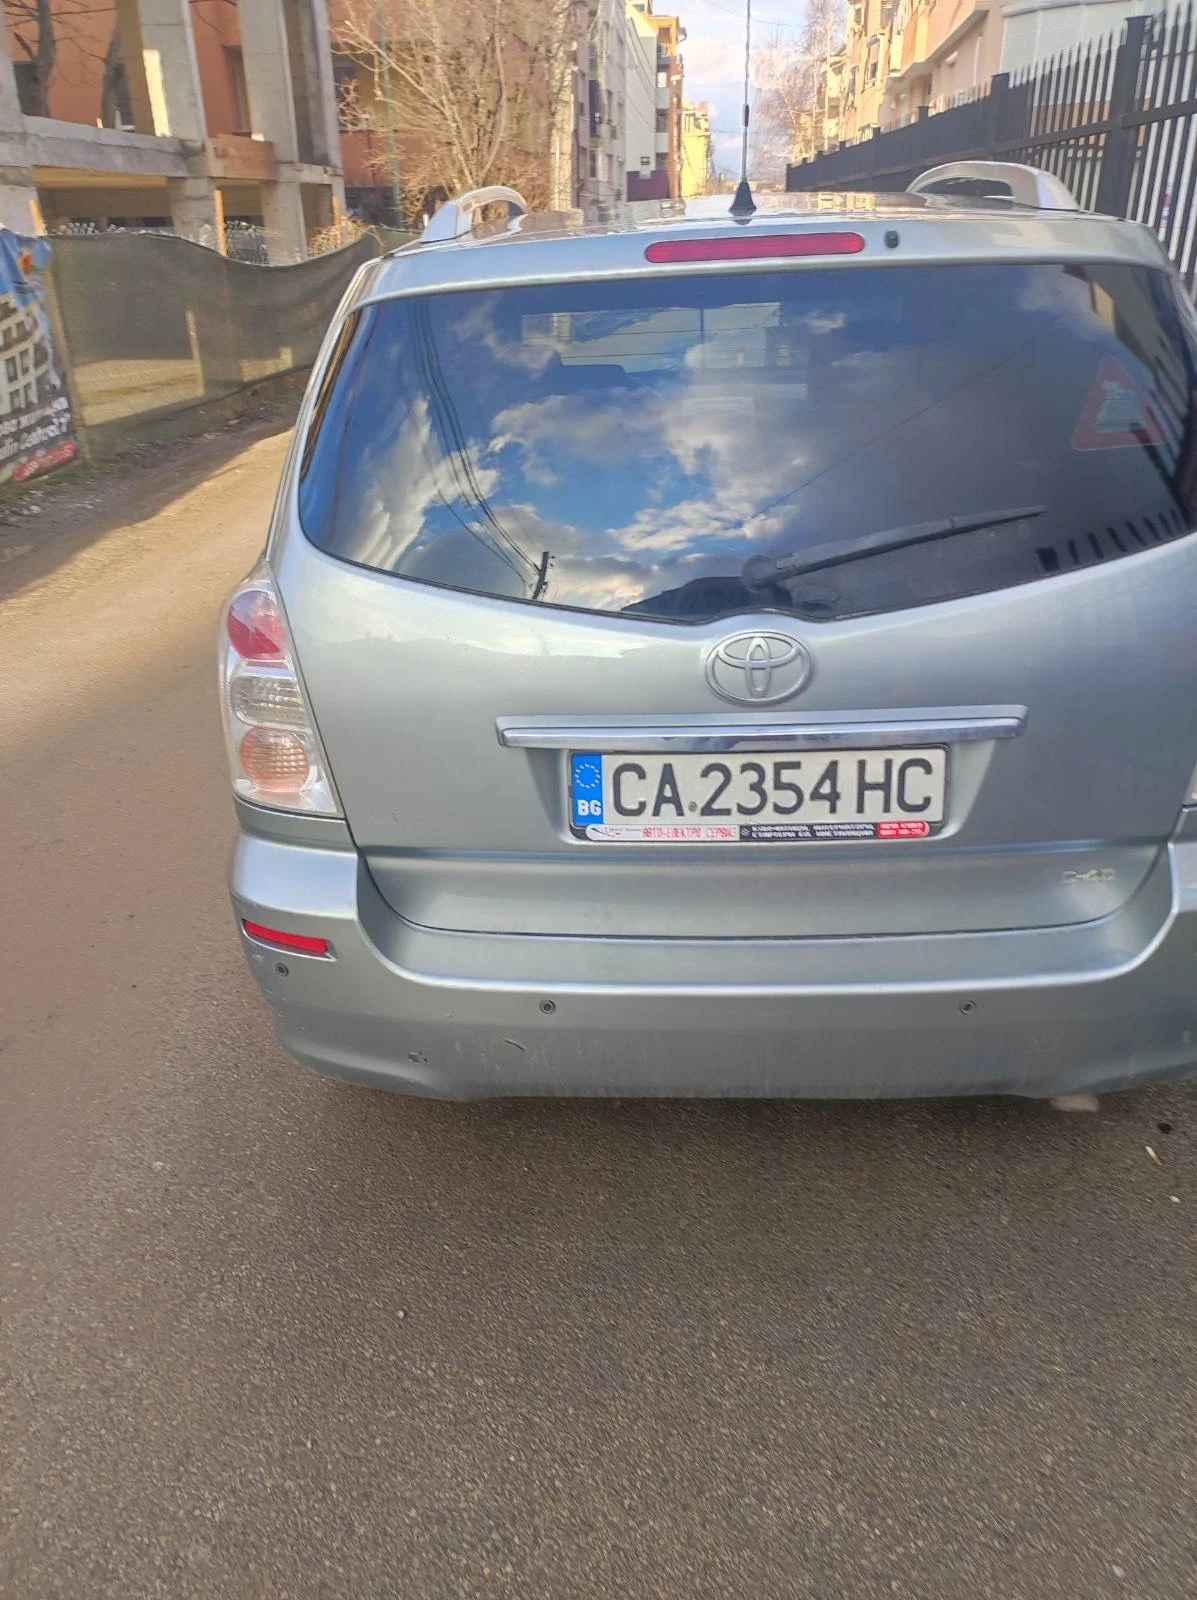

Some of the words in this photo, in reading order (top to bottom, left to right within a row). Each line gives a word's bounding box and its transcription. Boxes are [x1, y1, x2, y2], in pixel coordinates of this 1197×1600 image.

[612, 762, 685, 817] CA
[700, 760, 841, 817] 2354
[856, 757, 933, 814] HC
[577, 799, 602, 816] BG
